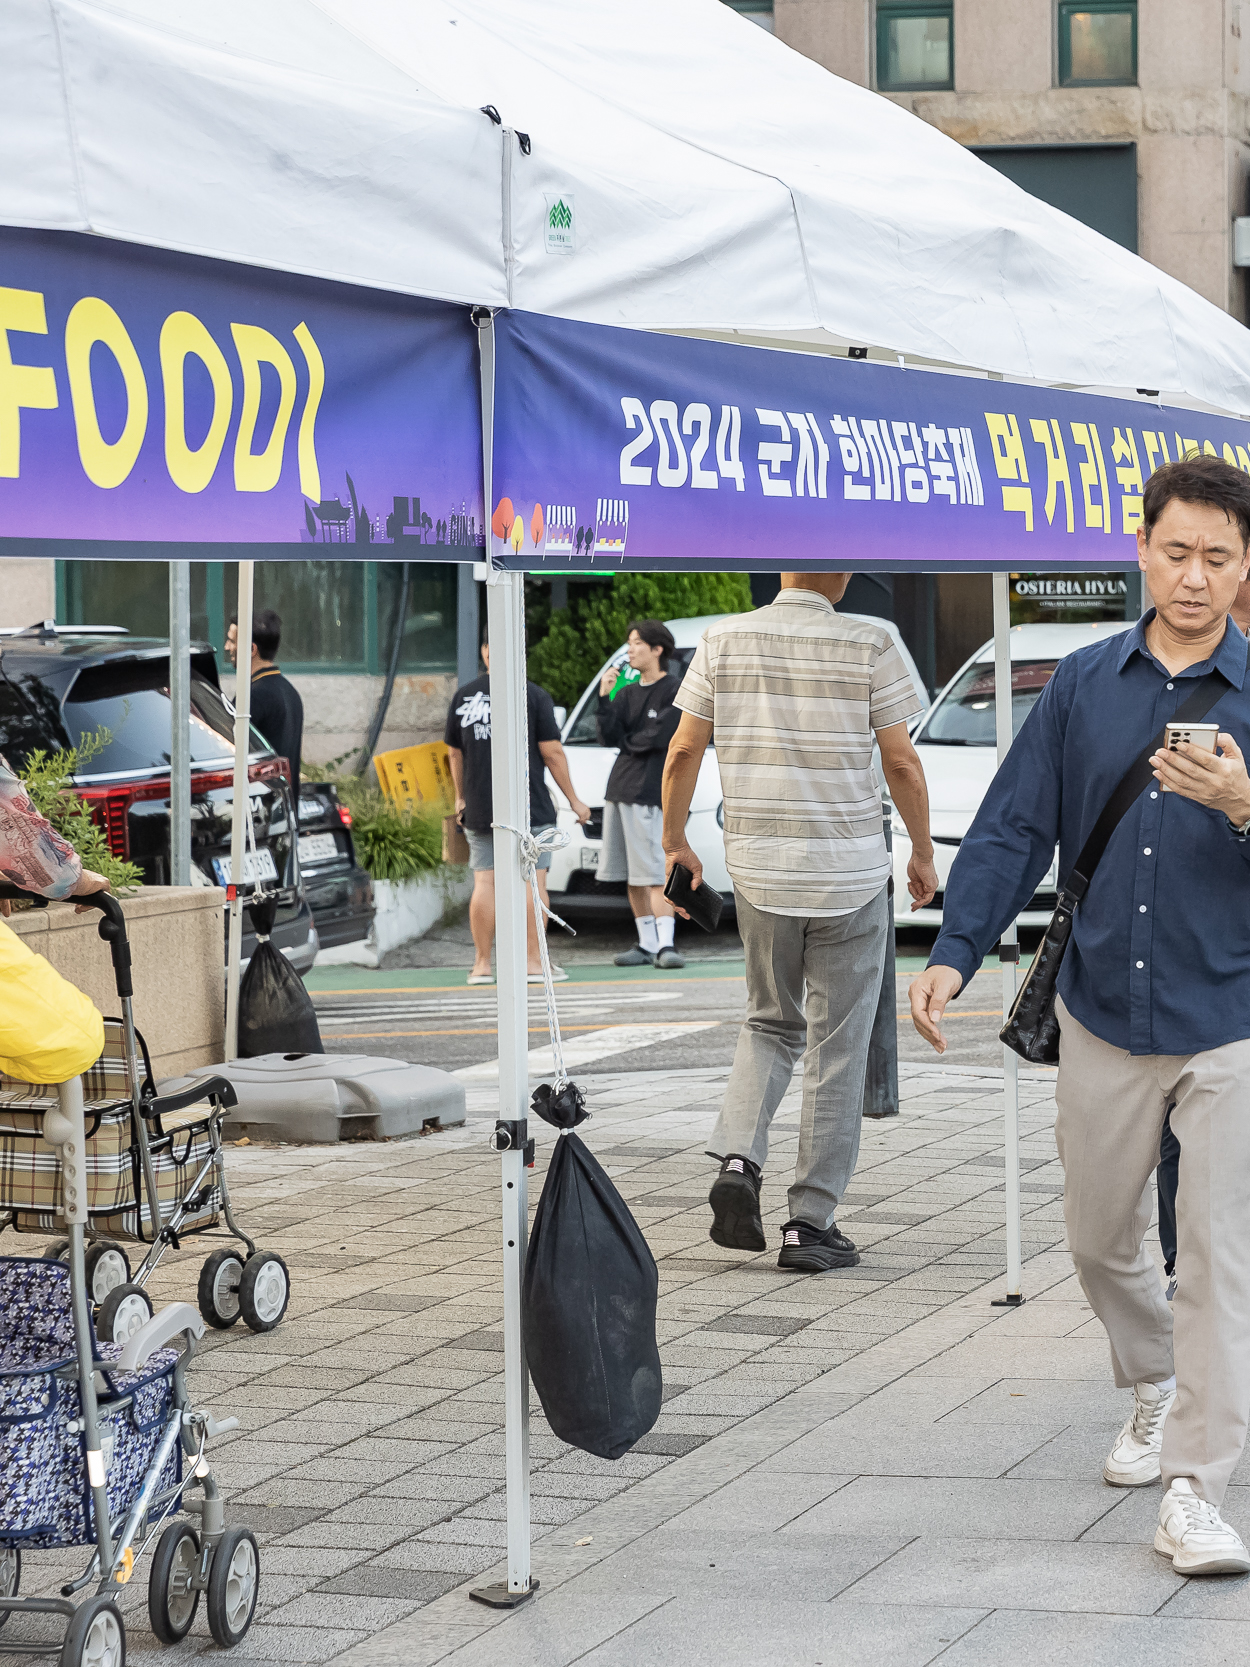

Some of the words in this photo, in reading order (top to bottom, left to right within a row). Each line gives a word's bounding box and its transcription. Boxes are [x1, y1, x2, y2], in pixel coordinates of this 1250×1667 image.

[620, 397, 745, 491] 2024
[755, 408, 829, 499] 군자
[829, 414, 984, 506] 한마당축제
[1015, 580, 1082, 595] OSTERIA
